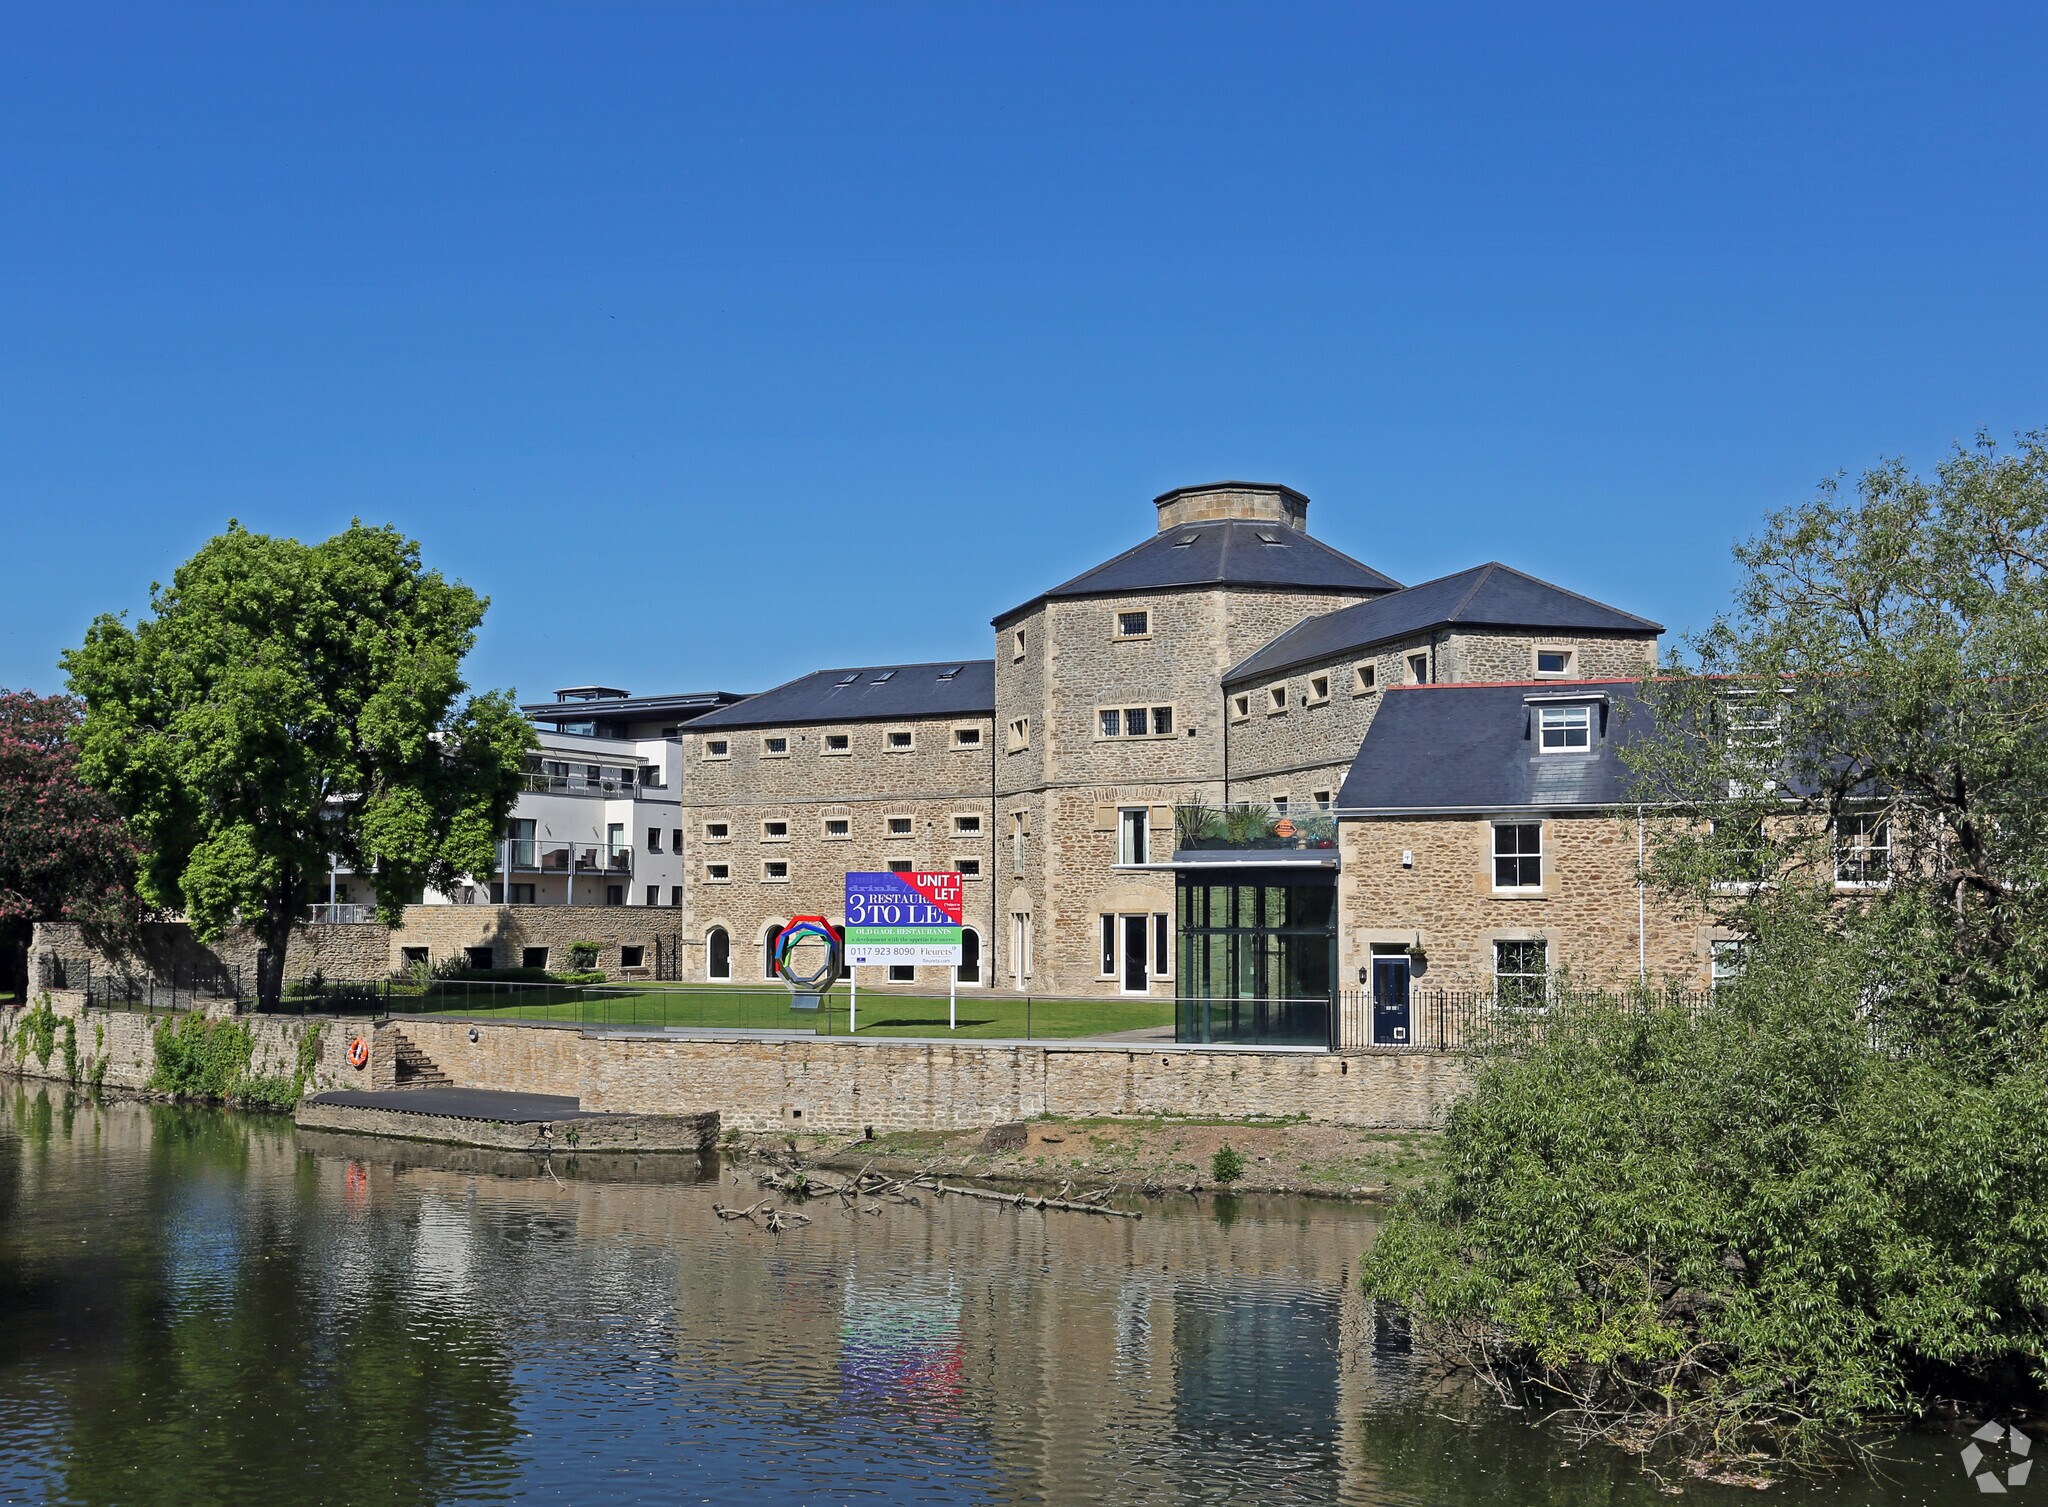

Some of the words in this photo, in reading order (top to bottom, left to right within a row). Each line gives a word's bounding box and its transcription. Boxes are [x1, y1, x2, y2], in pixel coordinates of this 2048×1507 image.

[917, 874, 950, 887] UNIT
[954, 874, 960, 887] 1
[848, 884, 899, 892] drink
[848, 893, 866, 924] 3
[868, 893, 933, 904] RESTAUR
[867, 904, 901, 924] TO
[850, 947, 873, 956] 0117
[874, 947, 891, 956] 923
[893, 947, 916, 956] 8090
[920, 947, 953, 956] Fleurets
